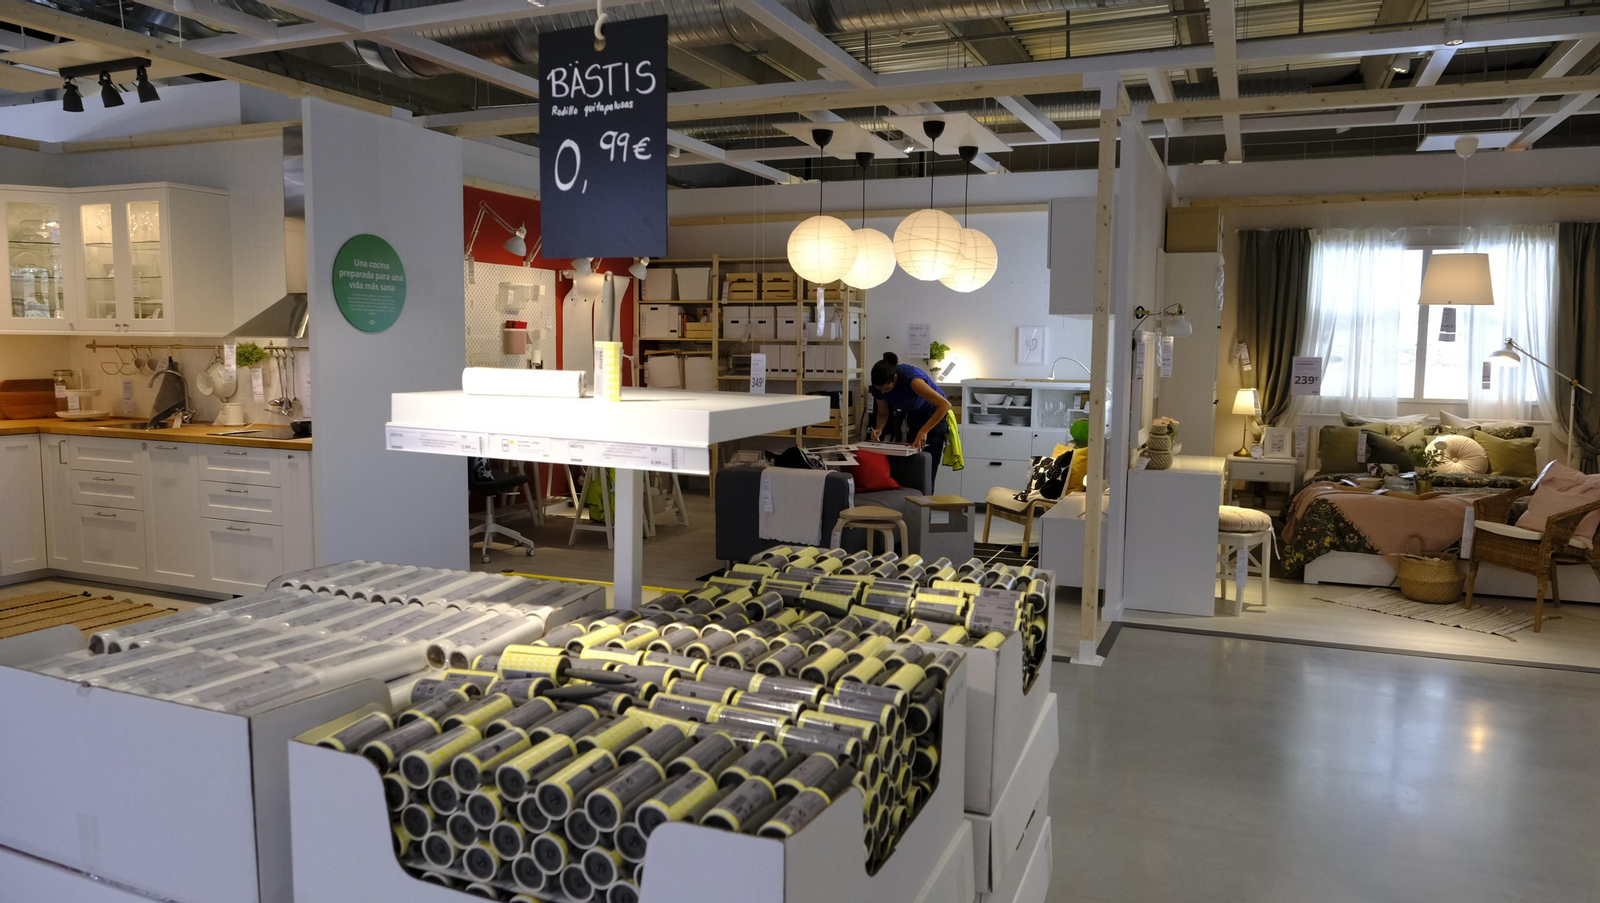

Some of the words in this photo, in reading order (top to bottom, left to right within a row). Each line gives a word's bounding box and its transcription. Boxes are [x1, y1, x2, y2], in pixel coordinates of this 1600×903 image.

[546, 60, 656, 98] BÄSTIS
[551, 105, 578, 116] Rodillo
[584, 100, 634, 117] quitapelusas
[354, 259, 368, 268] Una
[369, 261, 390, 270] cocina
[339, 270, 374, 280] preparada
[375, 273, 391, 282] para
[391, 274, 404, 282] una
[349, 281, 364, 290] vida
[364, 282, 380, 291] más
[380, 284, 396, 292] sana
